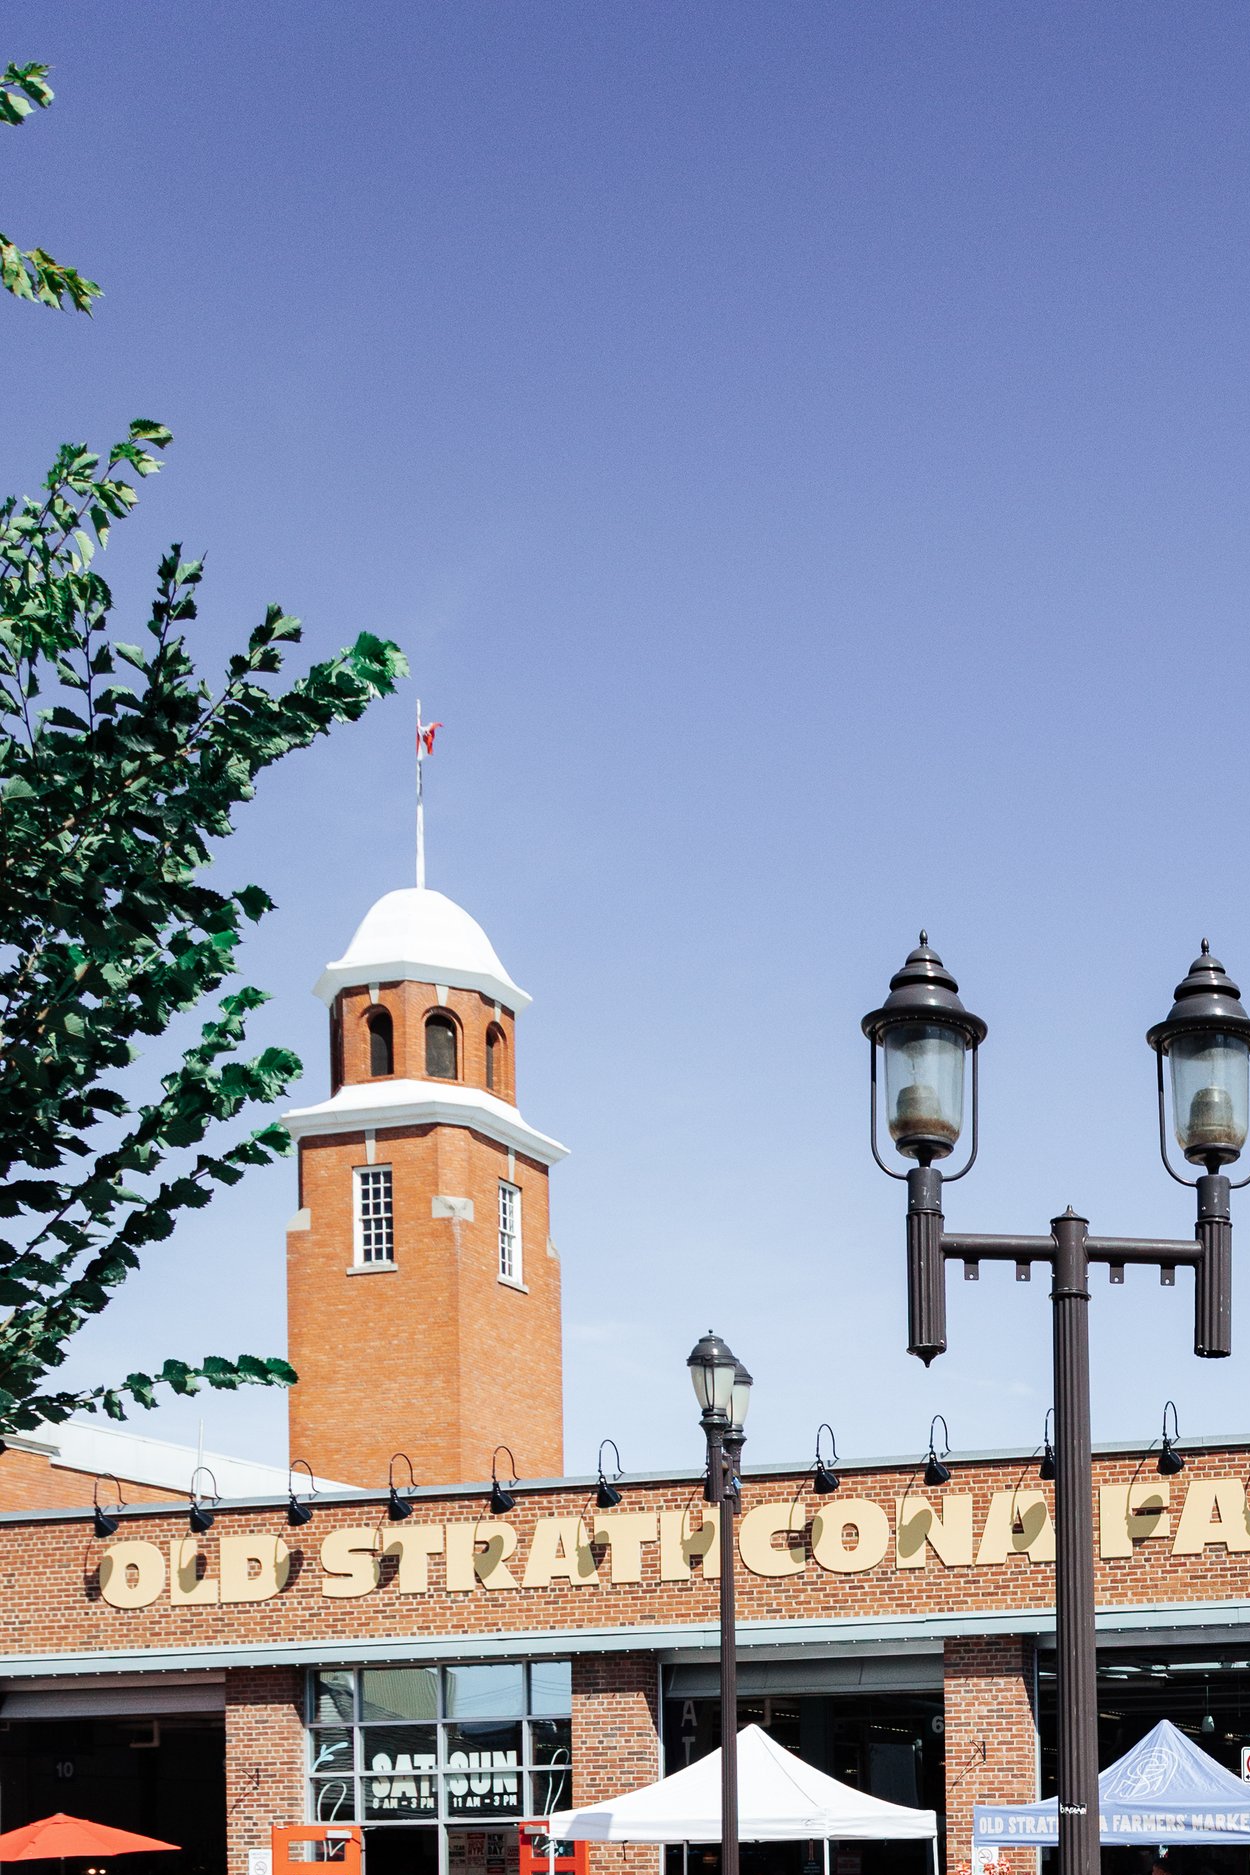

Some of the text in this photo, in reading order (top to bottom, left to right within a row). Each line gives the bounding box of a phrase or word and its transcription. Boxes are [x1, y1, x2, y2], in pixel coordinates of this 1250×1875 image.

[99, 1534, 290, 1610] OLD
[320, 1489, 1057, 1599] STRATHCONA
[931, 1715, 944, 1734] 6
[55, 1761, 74, 1778] 10
[372, 1753, 436, 1798] SAT
[450, 1750, 517, 1796] SUN
[383, 1798, 398, 1808] AM
[411, 1798, 417, 1808] 3
[420, 1797, 434, 1808] PM
[453, 1797, 462, 1807] 11
[466, 1797, 480, 1807] AM
[493, 1796, 500, 1806] 3
[503, 1795, 517, 1806] PM
[979, 1816, 1004, 1834] OLD
[1112, 1814, 1188, 1832] FARMERS'
